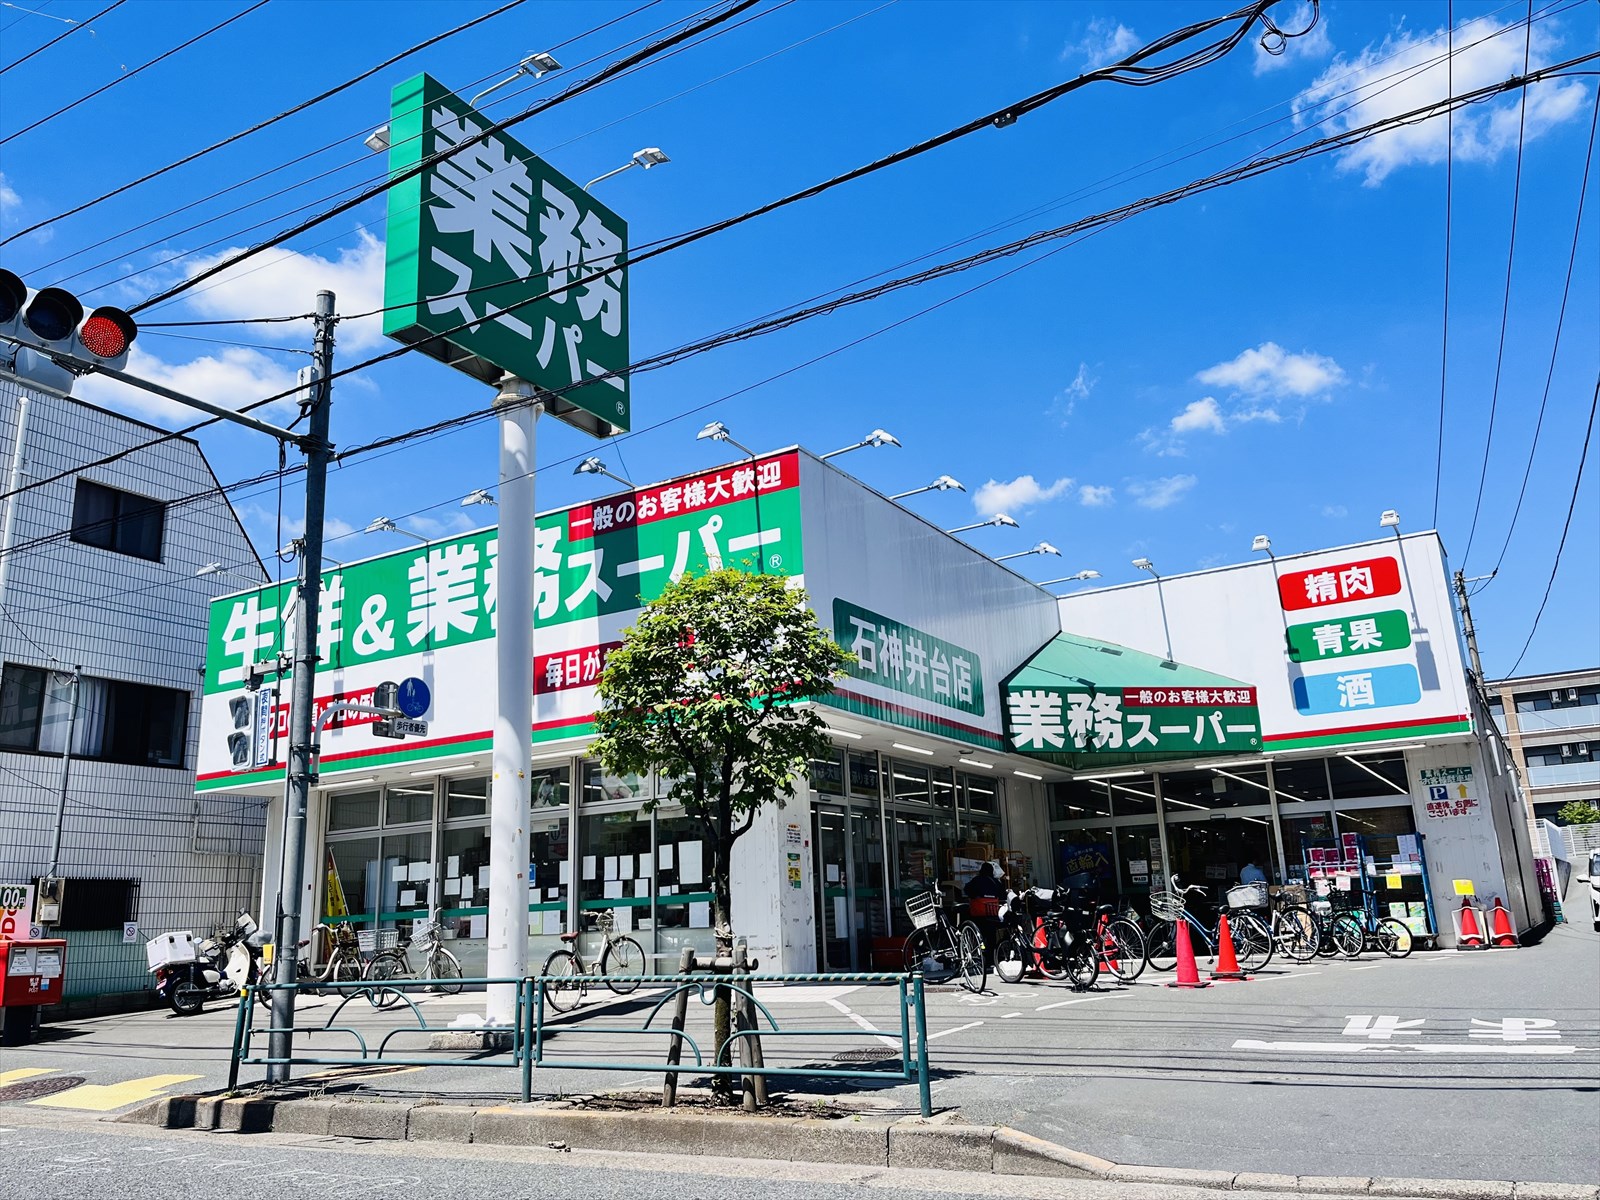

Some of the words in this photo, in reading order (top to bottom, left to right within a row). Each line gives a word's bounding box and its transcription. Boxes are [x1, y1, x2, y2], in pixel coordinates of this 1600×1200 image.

[428, 105, 623, 337] 業務
[426, 246, 625, 392] スーパー
[571, 461, 782, 531] 一般のお客様大歓迎
[1304, 567, 1375, 603] 精肉
[1312, 618, 1383, 656] 青果
[545, 647, 612, 688] 毎日が
[850, 616, 972, 705] 石神井台店
[1125, 690, 1251, 704] 一般のお客様大歓迎
[1336, 672, 1376, 708] 酒
[397, 721, 426, 733] 歩行者優先
[1006, 690, 1256, 749] 業務スーパー
[1431, 787, 1446, 800] P
[0, 889, 27, 908] 00円
